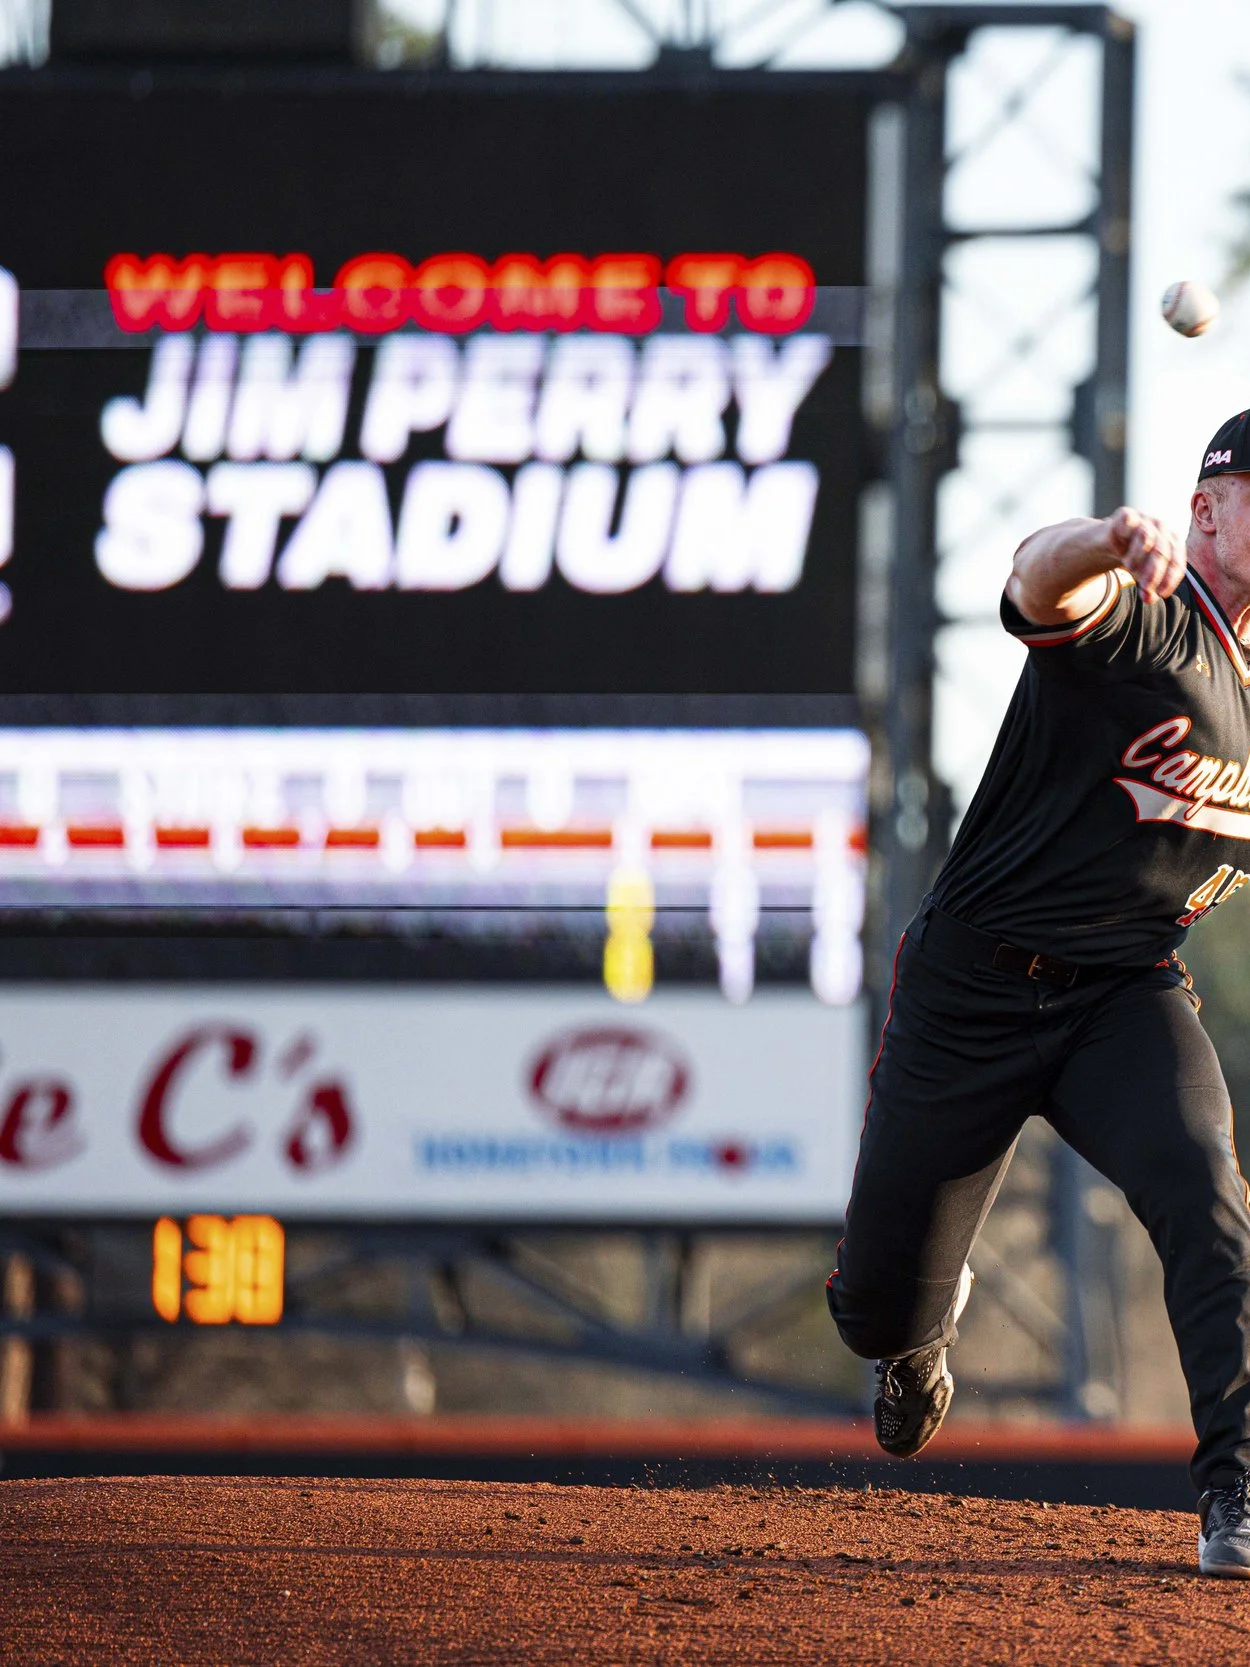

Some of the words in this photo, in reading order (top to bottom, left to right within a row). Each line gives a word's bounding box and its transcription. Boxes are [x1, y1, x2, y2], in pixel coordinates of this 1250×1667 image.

[105, 252, 661, 333] WELCOME
[667, 252, 816, 333] TO
[100, 334, 355, 462] JIM
[360, 334, 833, 463] PERRY
[1204, 450, 1232, 468] CAA
[95, 460, 819, 592] STADIUM
